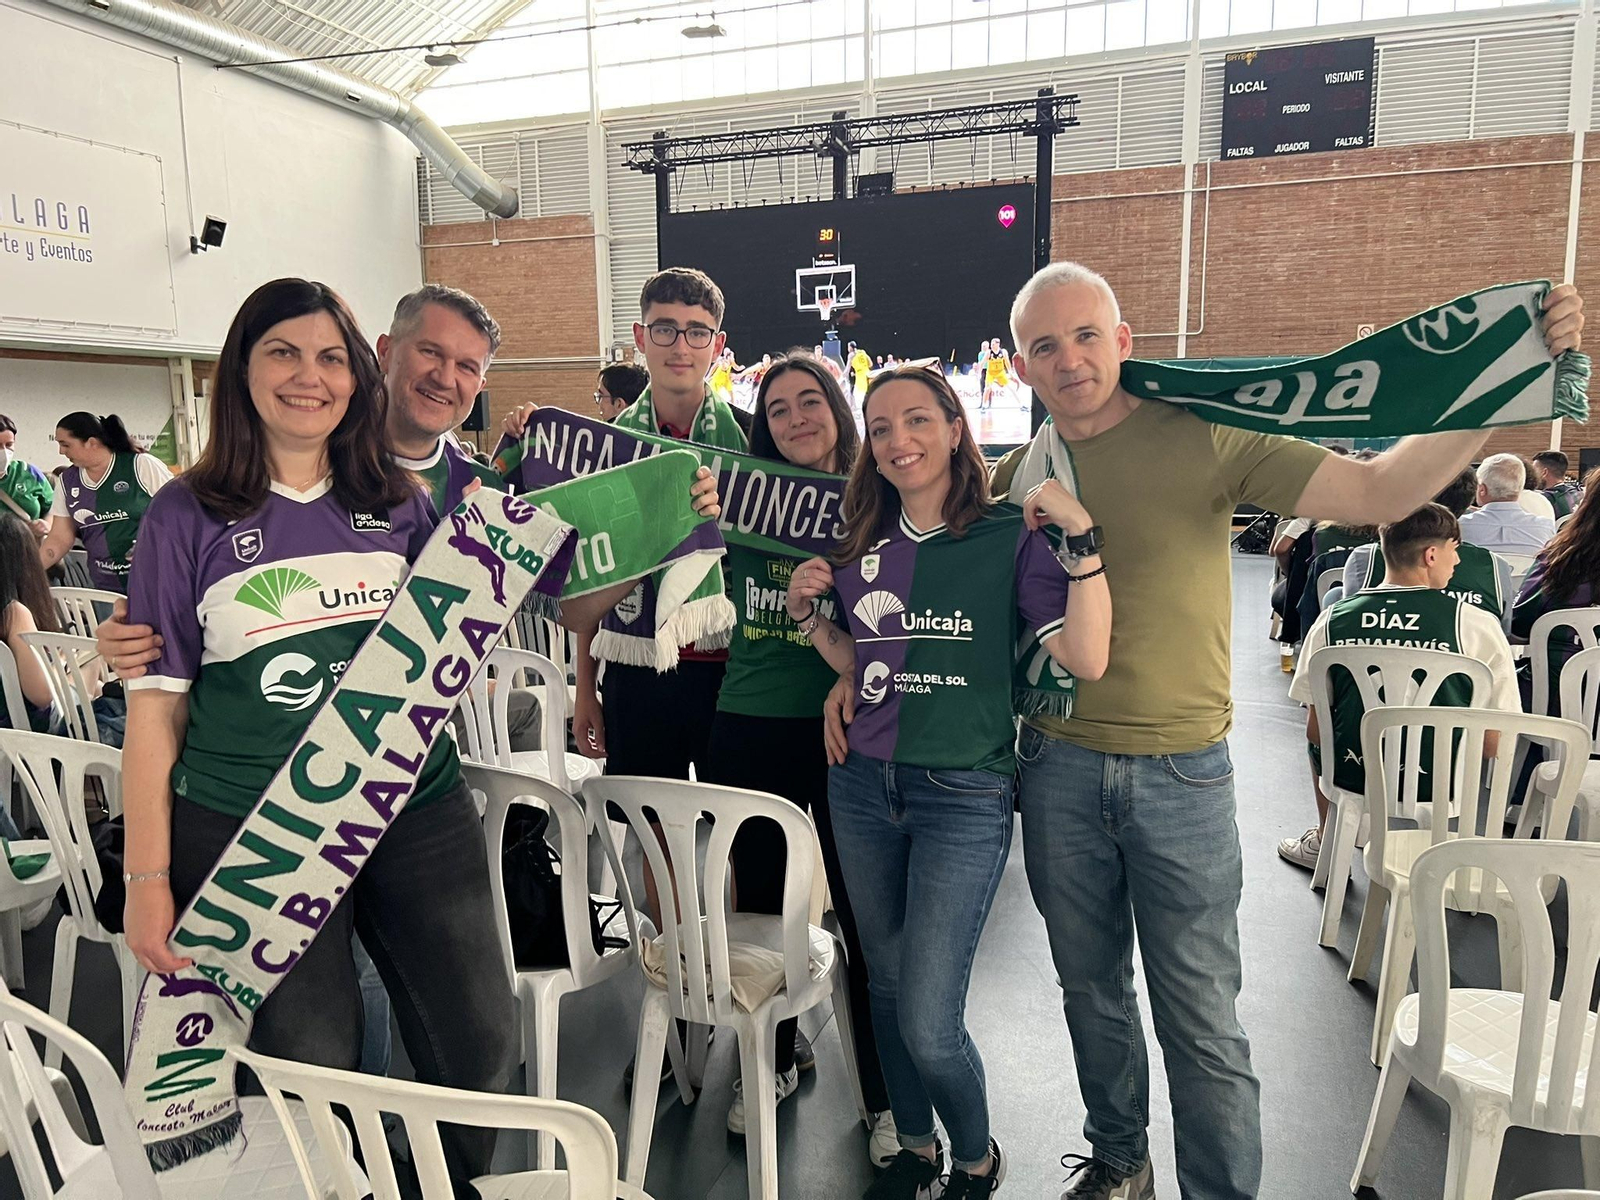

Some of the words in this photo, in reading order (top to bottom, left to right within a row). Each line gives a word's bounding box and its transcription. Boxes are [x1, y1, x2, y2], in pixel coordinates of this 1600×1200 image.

[1324, 70, 1365, 84] VISITANTE
[1229, 80, 1268, 94] LOCAL
[1282, 103, 1311, 114] PERIODO
[1274, 142, 1310, 153] JUGADOR
[1335, 136, 1364, 147] FALTAS
[1227, 147, 1255, 157] FALTAS
[10, 193, 90, 234] LAGA
[1000, 209, 1015, 220] 101
[819, 229, 834, 241] 30
[26, 241, 34, 261] y
[40, 238, 93, 263] Eventos
[1233, 360, 1381, 425] aja
[94, 509, 128, 521] Unicaja
[356, 519, 390, 529] endesa
[484, 523, 544, 576] ACB
[772, 564, 792, 577] FIN
[1441, 590, 1483, 604] AVÍS
[901, 609, 973, 636] Unicaja
[1361, 608, 1421, 631] DÍAZ
[893, 673, 921, 683] COSTA
[923, 674, 944, 685] DEL
[945, 676, 968, 686] SOL
[172, 575, 471, 952] UNICAJA
[196, 964, 264, 1012] ACB
[165, 1099, 194, 1118] Club
[137, 1119, 185, 1132] loncesto
